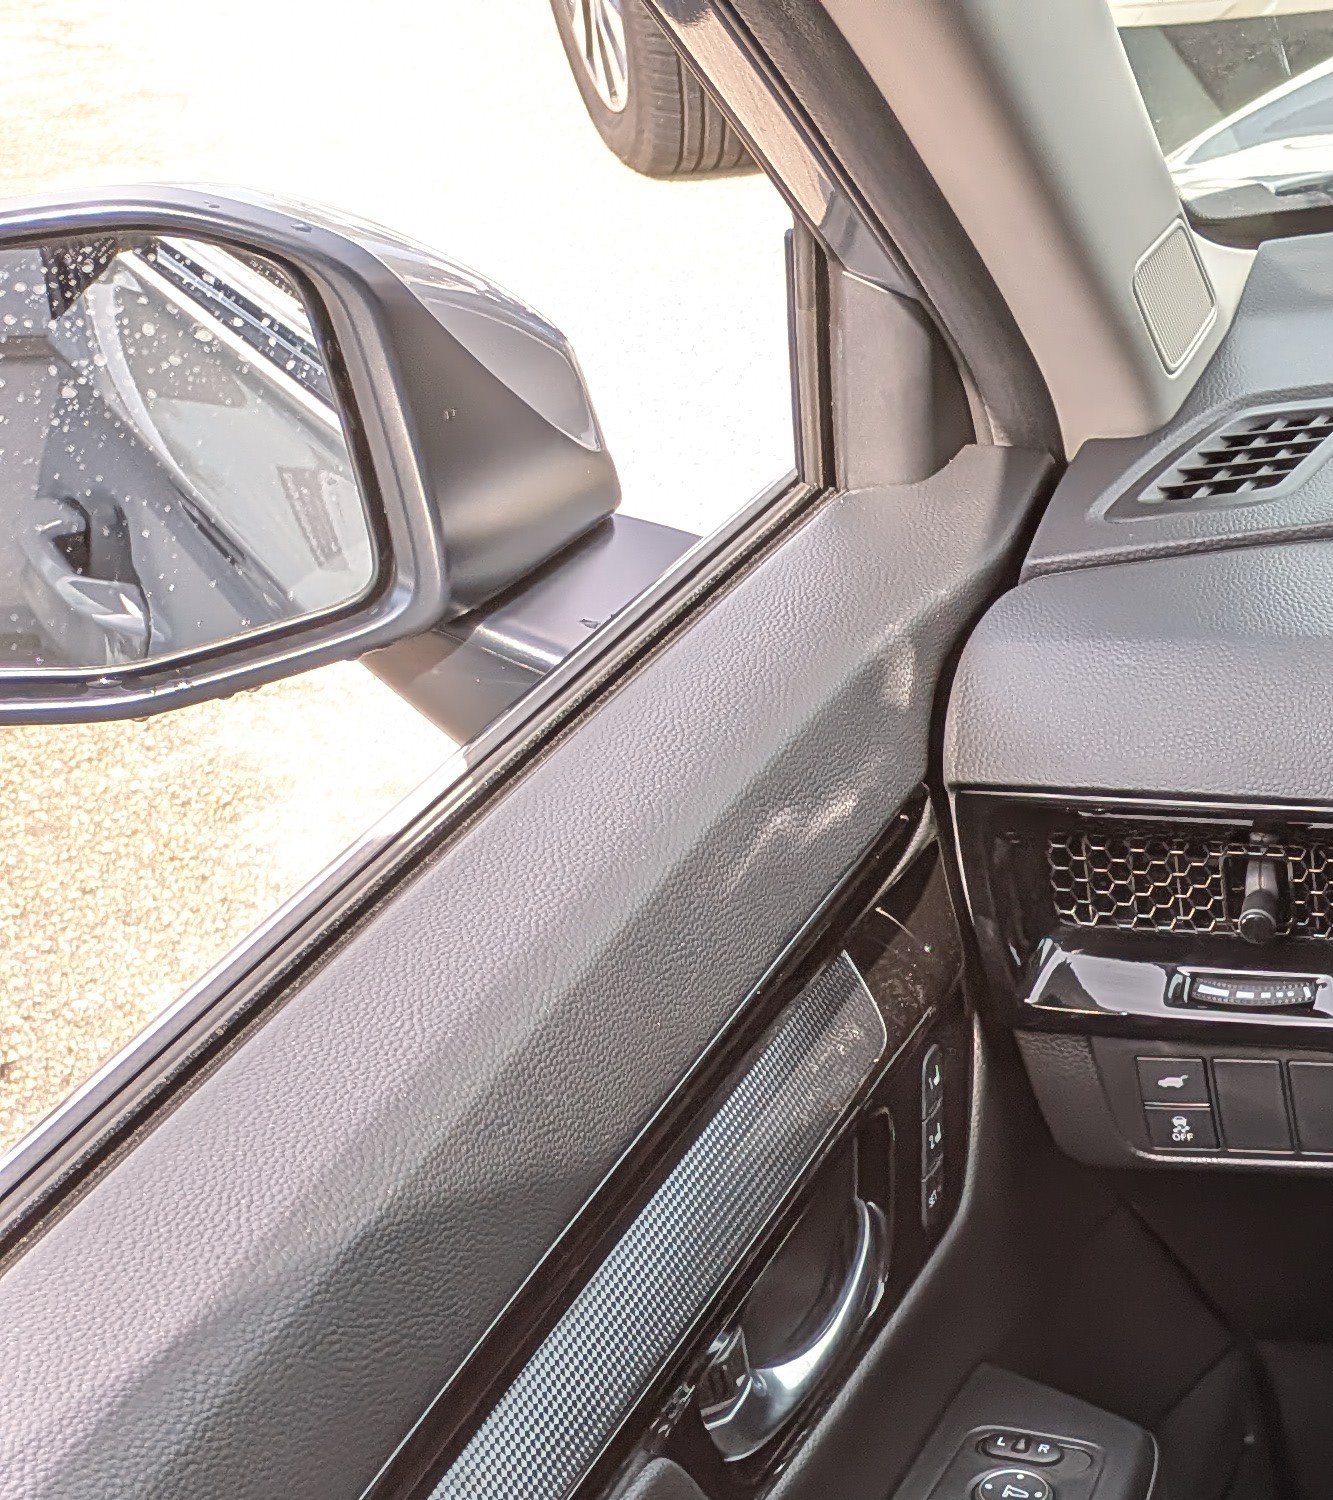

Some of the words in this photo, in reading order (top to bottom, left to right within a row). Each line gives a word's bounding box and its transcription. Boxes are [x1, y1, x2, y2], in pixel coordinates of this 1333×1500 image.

[1171, 1132, 1194, 1142] OFF
[996, 1436, 1006, 1447] L
[1037, 1443, 1050, 1454] R
